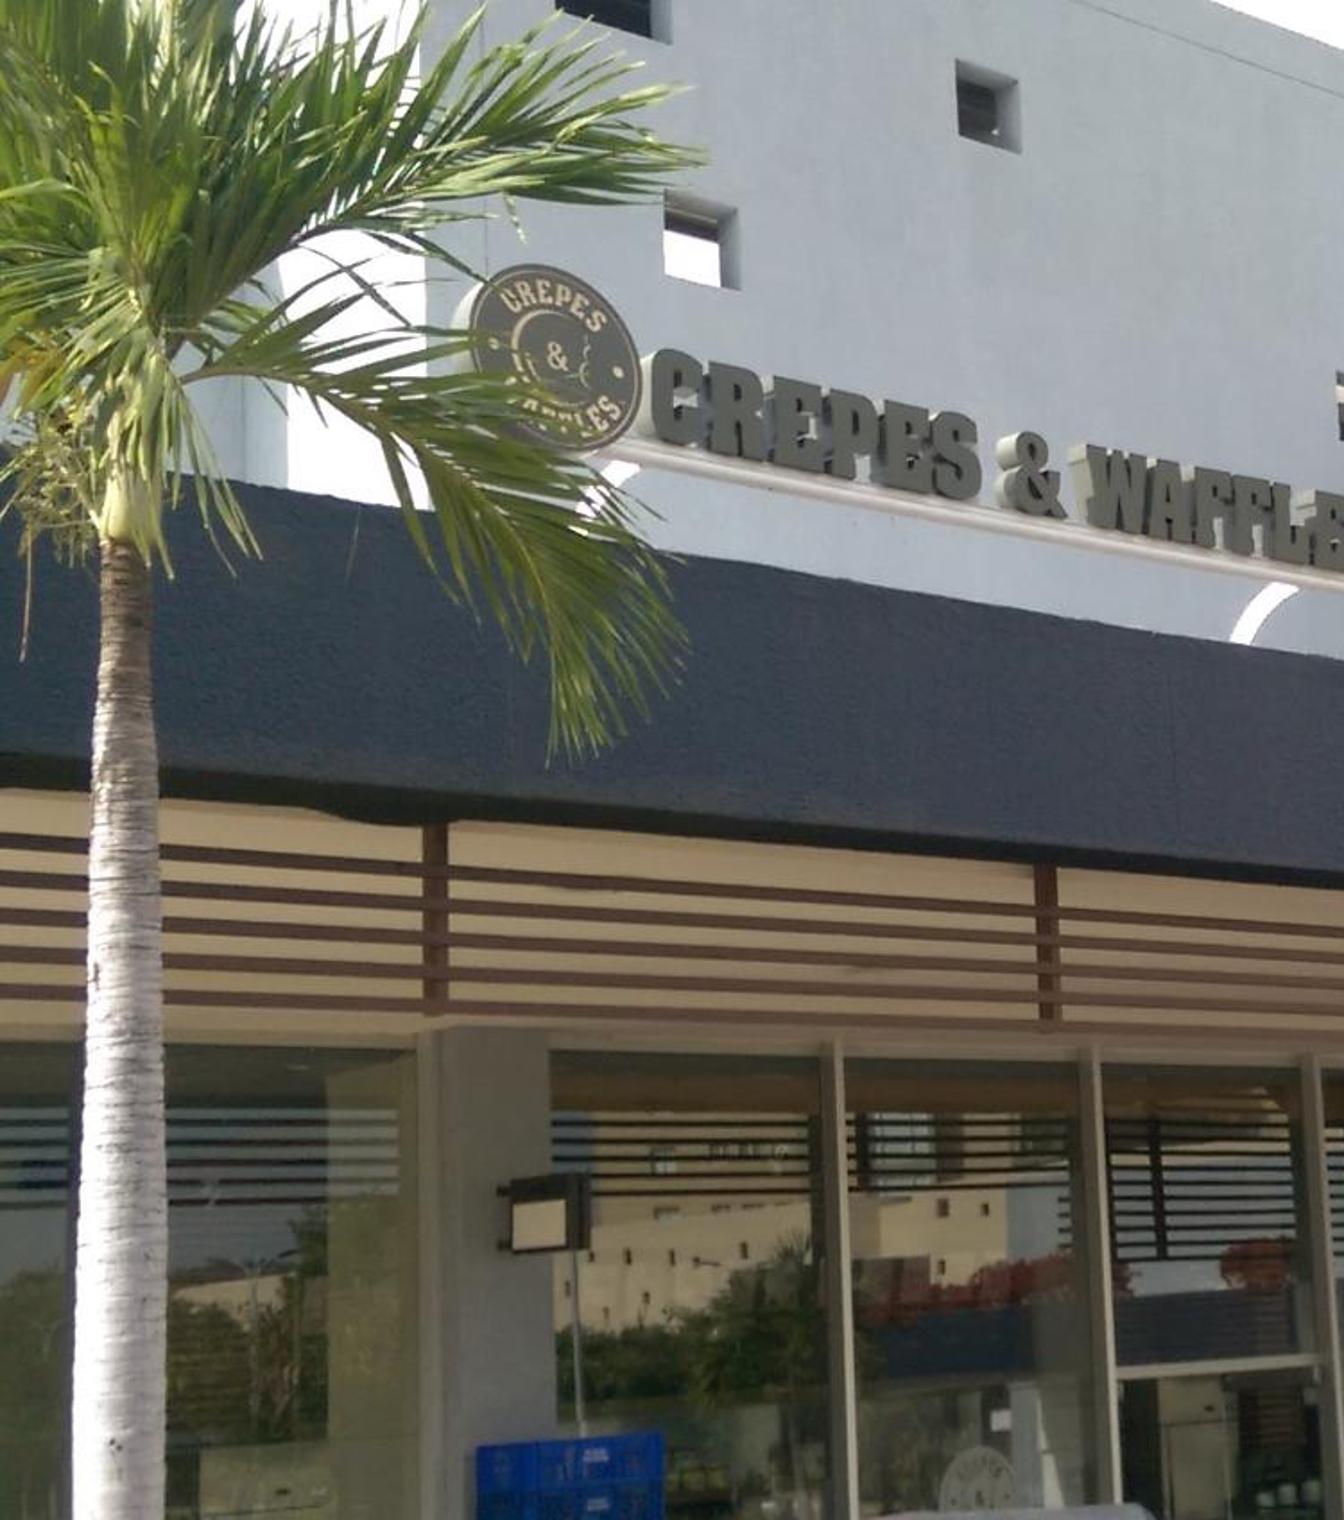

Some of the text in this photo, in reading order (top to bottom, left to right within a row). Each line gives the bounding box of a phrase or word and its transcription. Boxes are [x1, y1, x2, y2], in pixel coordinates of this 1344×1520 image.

[500, 279, 608, 333] CREPES
[546, 341, 569, 373] &
[503, 376, 622, 438] ALES
[649, 347, 983, 501] CREPES
[1003, 430, 1067, 519] &
